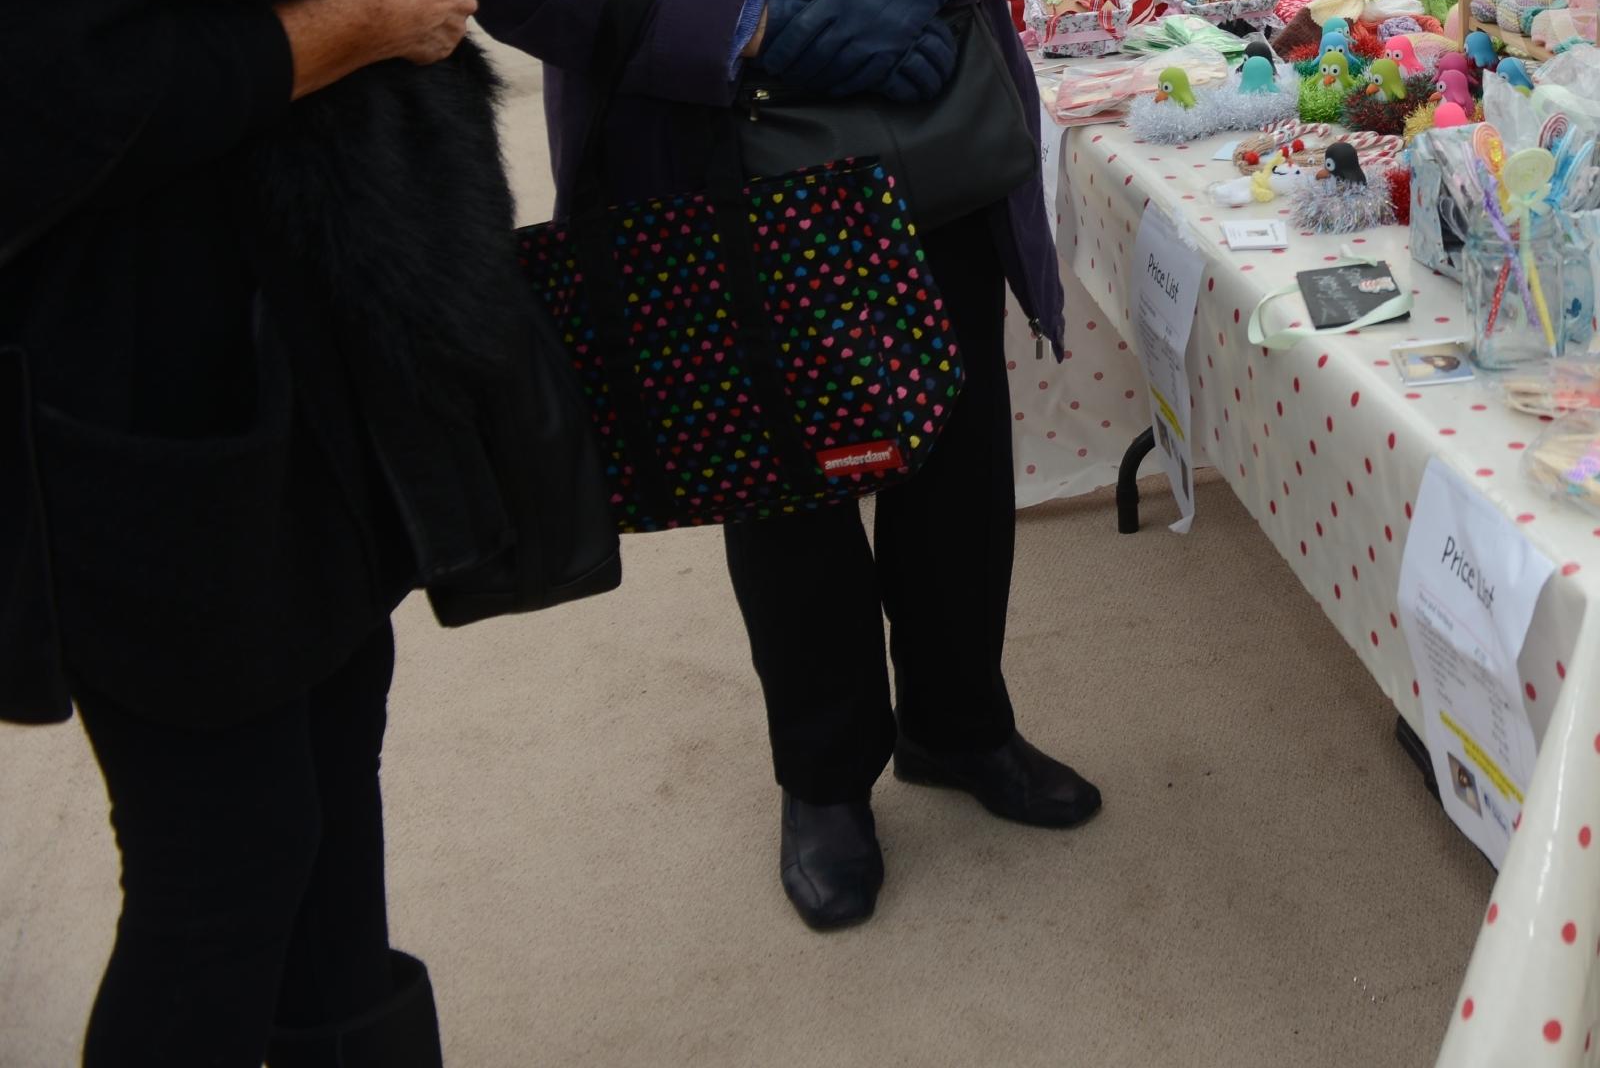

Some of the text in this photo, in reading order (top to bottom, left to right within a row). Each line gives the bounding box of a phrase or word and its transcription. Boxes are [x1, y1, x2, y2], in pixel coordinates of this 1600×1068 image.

[1147, 252, 1179, 303] Price List
[825, 450, 891, 469] amsterdam
[1441, 535, 1495, 609] Price List
